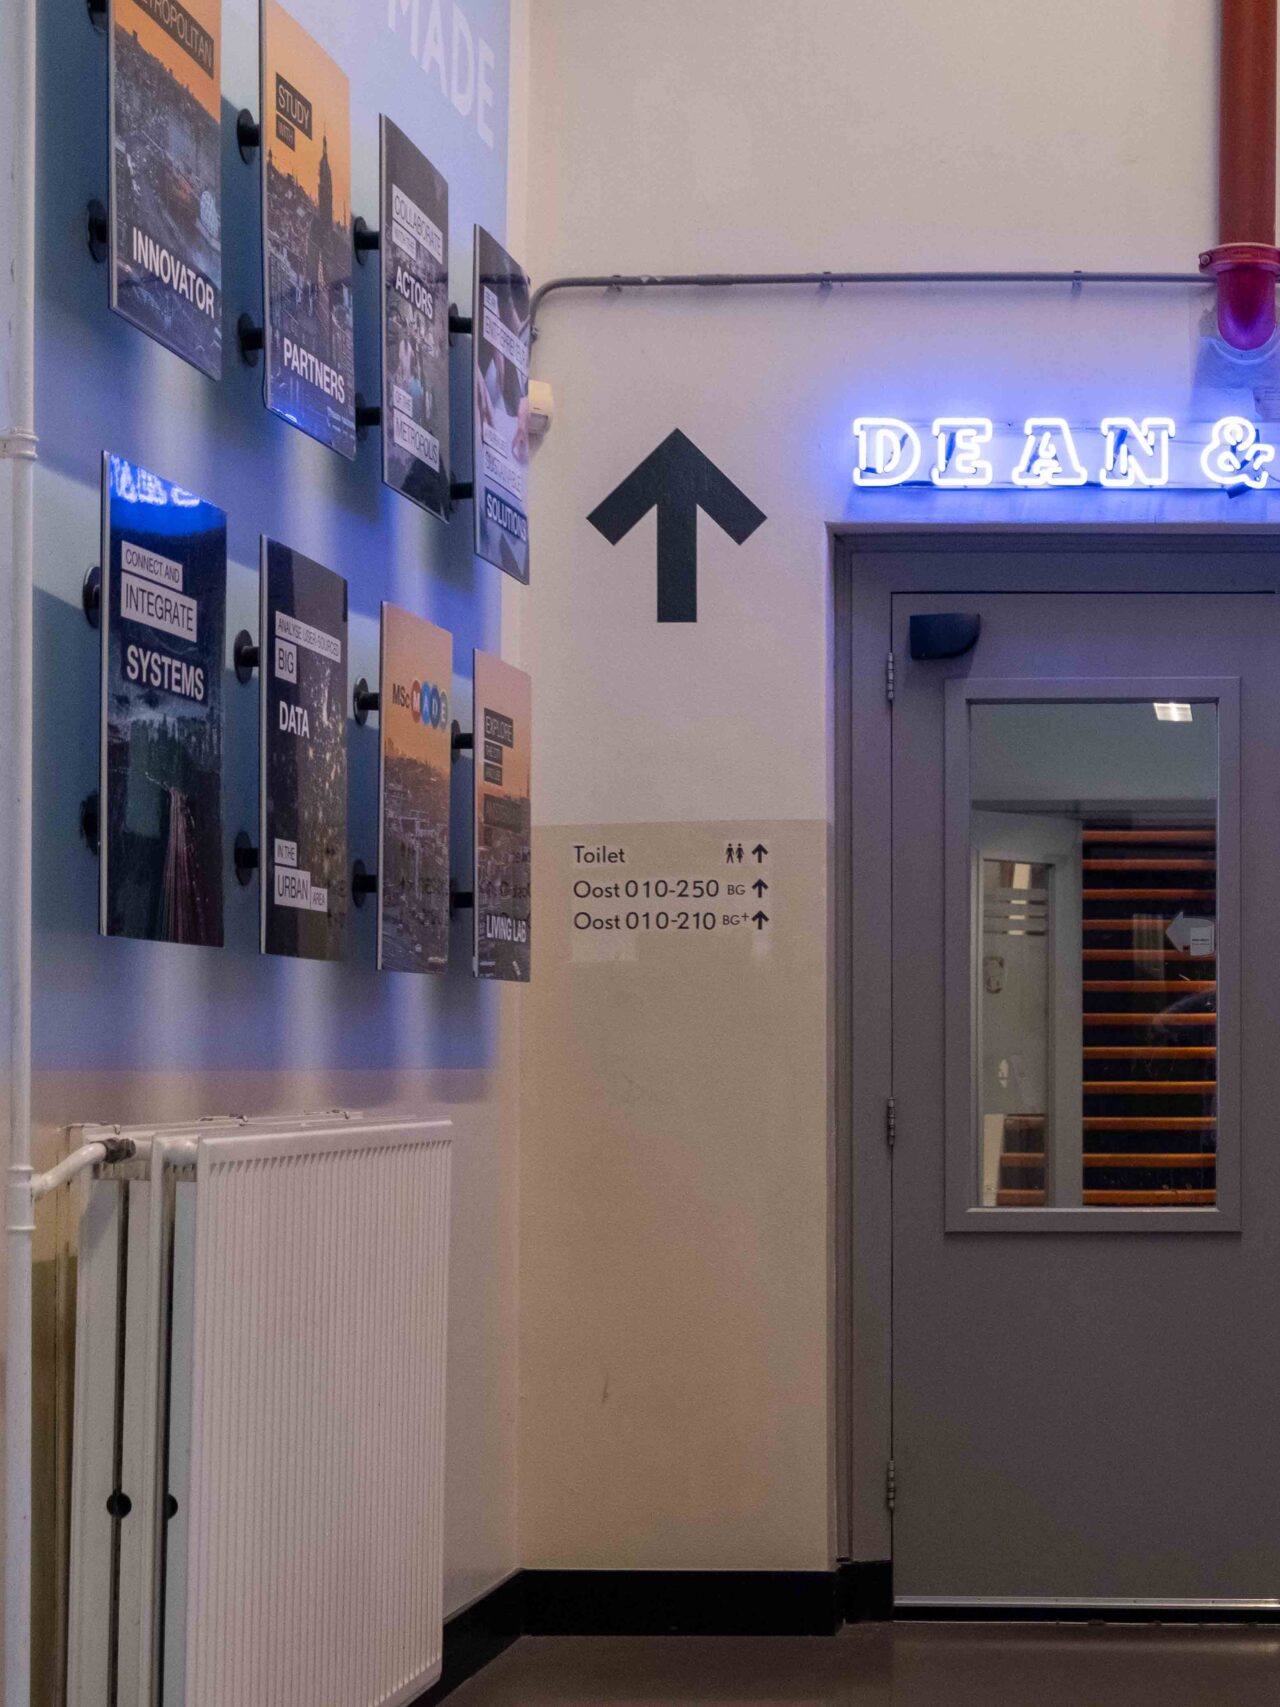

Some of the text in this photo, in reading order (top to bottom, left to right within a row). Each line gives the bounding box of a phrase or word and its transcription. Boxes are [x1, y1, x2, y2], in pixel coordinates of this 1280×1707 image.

[144, 0, 213, 68] ROPOLITAN
[278, 85, 310, 129] STUDY
[133, 227, 215, 319] INNOVATOR
[395, 266, 433, 320] ACTORS
[283, 337, 345, 404] PARTNERS
[852, 417, 1176, 487] DEAN
[1200, 416, 1276, 489] &
[487, 493, 527, 542] SOLUTIONS
[125, 548, 180, 584] CONNECT AND
[126, 583, 194, 632] INTEGRATE
[126, 644, 204, 701] SYSTEMS
[278, 647, 294, 674] BIG
[392, 683, 410, 709] MSc
[279, 700, 310, 739] DATA
[573, 845, 625, 864] Toilet
[277, 875, 325, 906] URBAN AREA
[573, 879, 746, 899] Oost 010-250 BG
[486, 914, 527, 943] LIVING LAB
[574, 911, 621, 930] Oost
[625, 911, 716, 930] 010-210
